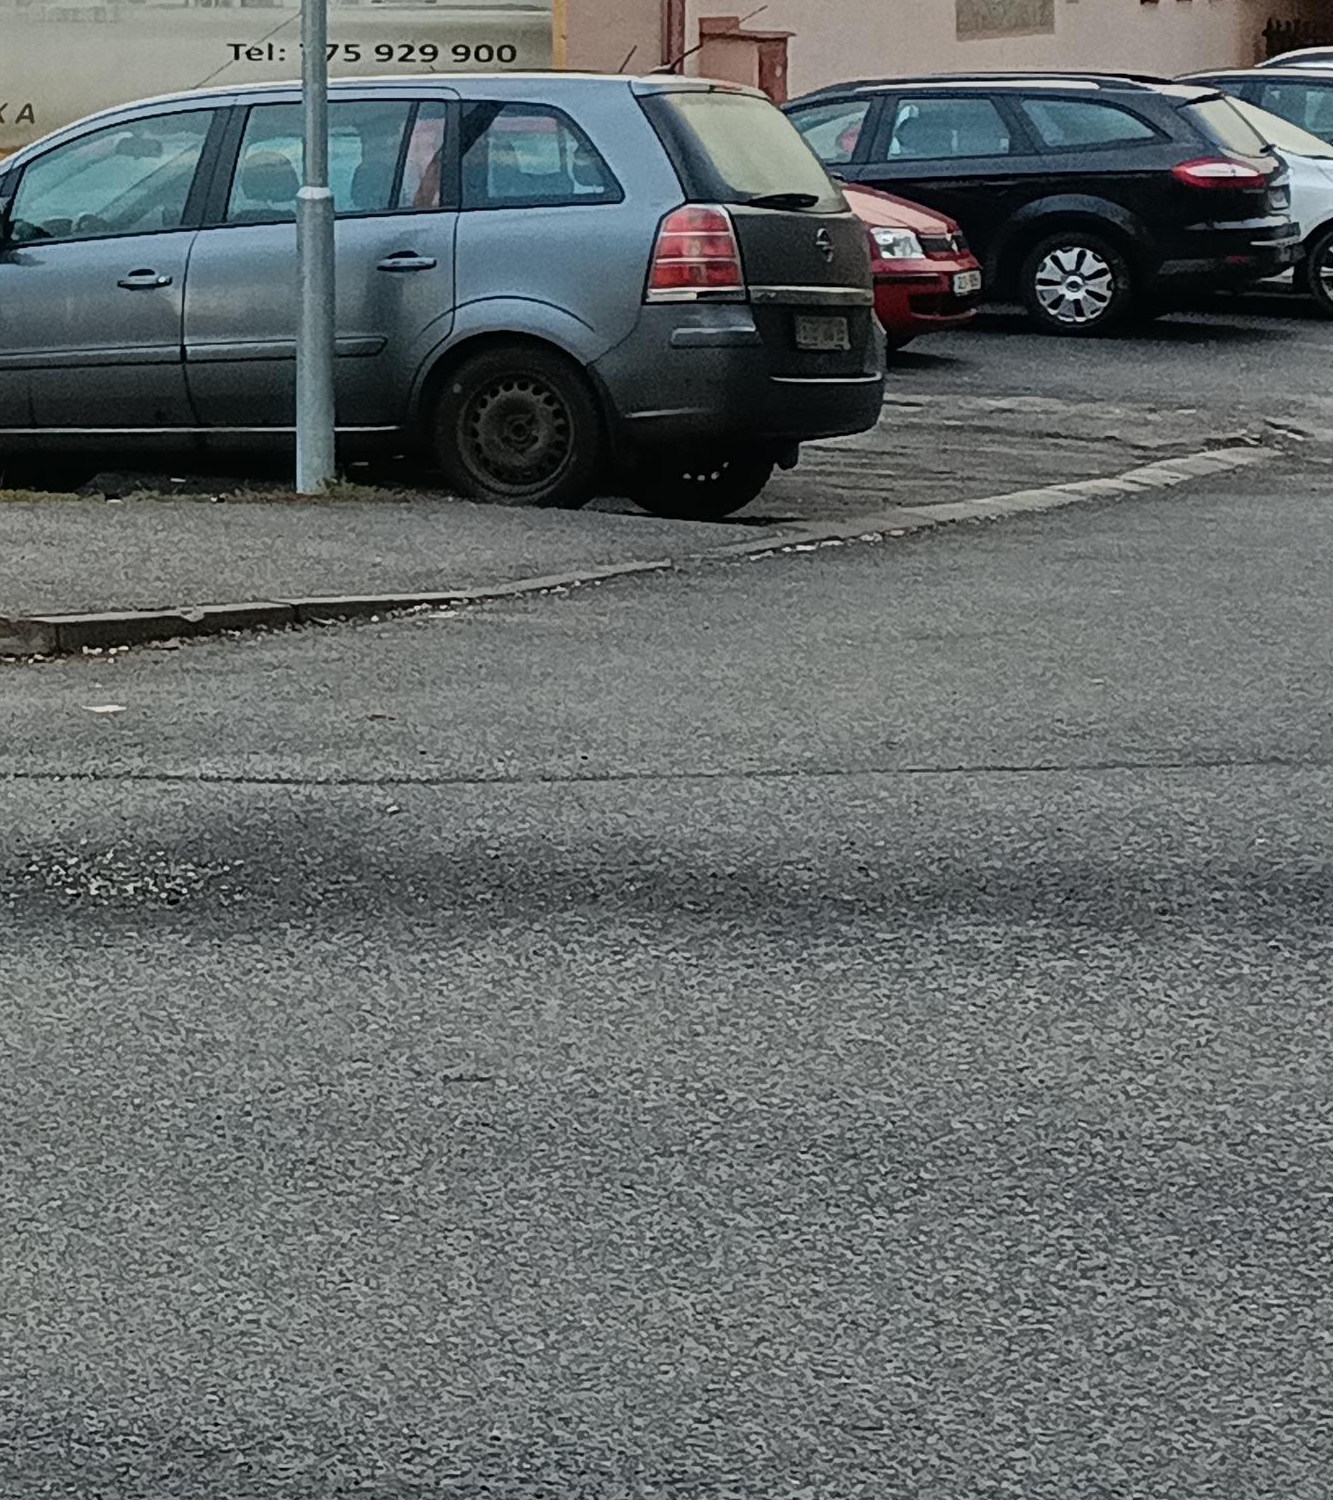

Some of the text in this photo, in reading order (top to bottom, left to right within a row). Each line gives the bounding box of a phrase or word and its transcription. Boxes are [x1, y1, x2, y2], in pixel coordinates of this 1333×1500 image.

[227, 43, 285, 62] Tel:
[374, 43, 439, 64] 929
[451, 43, 517, 63] 900
